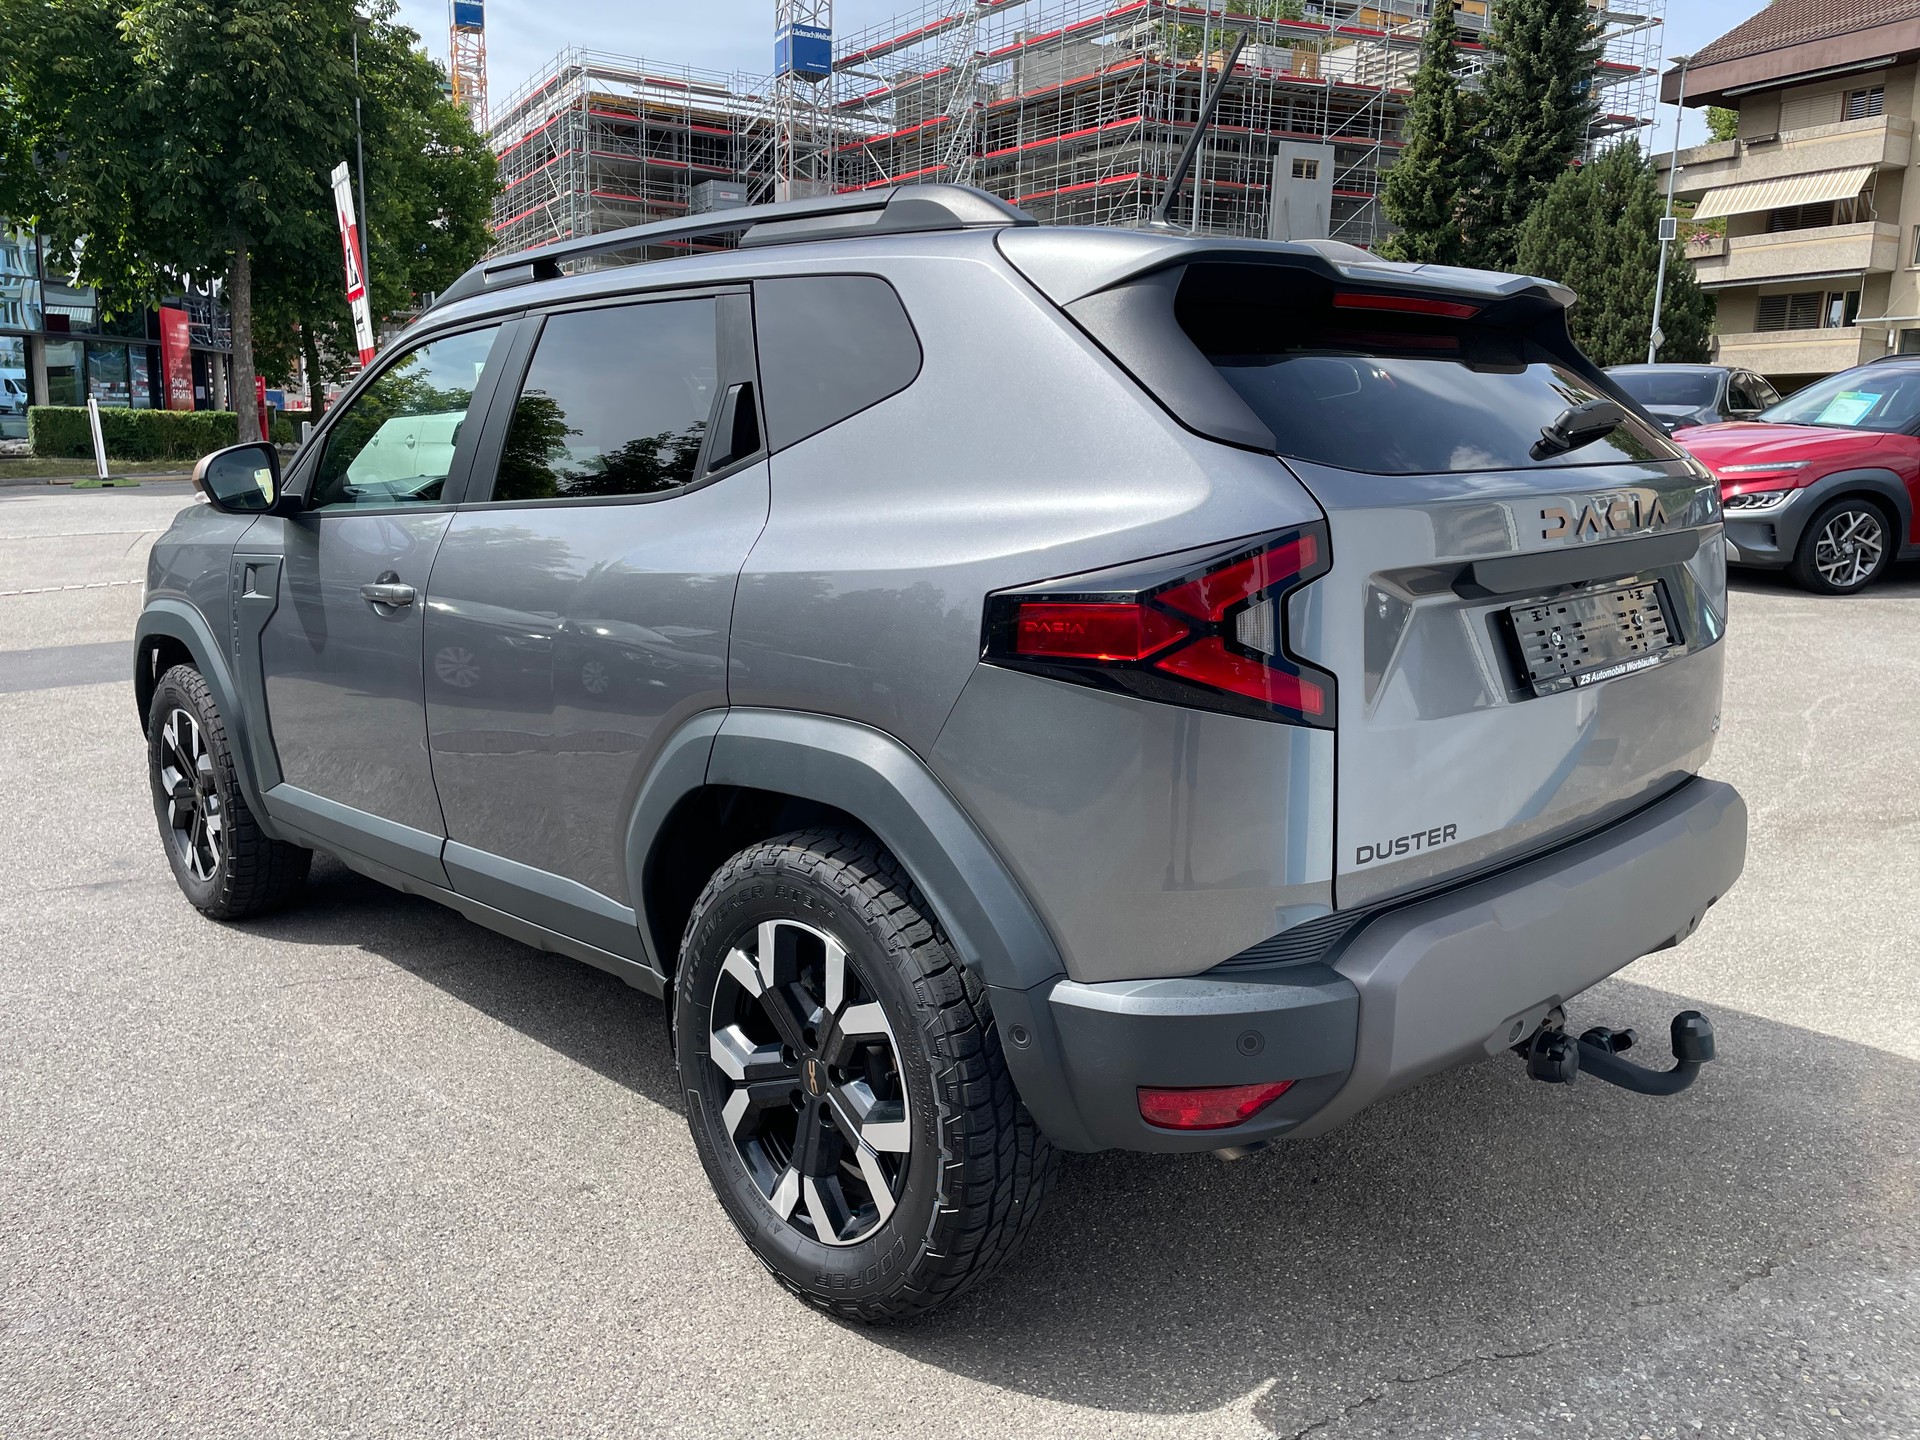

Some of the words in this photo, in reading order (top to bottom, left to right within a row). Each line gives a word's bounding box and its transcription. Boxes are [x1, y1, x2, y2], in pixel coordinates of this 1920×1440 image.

[172, 388, 192, 400] SPORTS
[1540, 498, 1669, 539] DACIA
[1025, 621, 1085, 634] DACIA
[1580, 673, 1591, 685] ZS
[1591, 664, 1626, 682] Automobile
[1626, 656, 1659, 672] Worblaufen
[1356, 823, 1457, 865] DUSTER
[815, 1234, 907, 1290] COOPER
